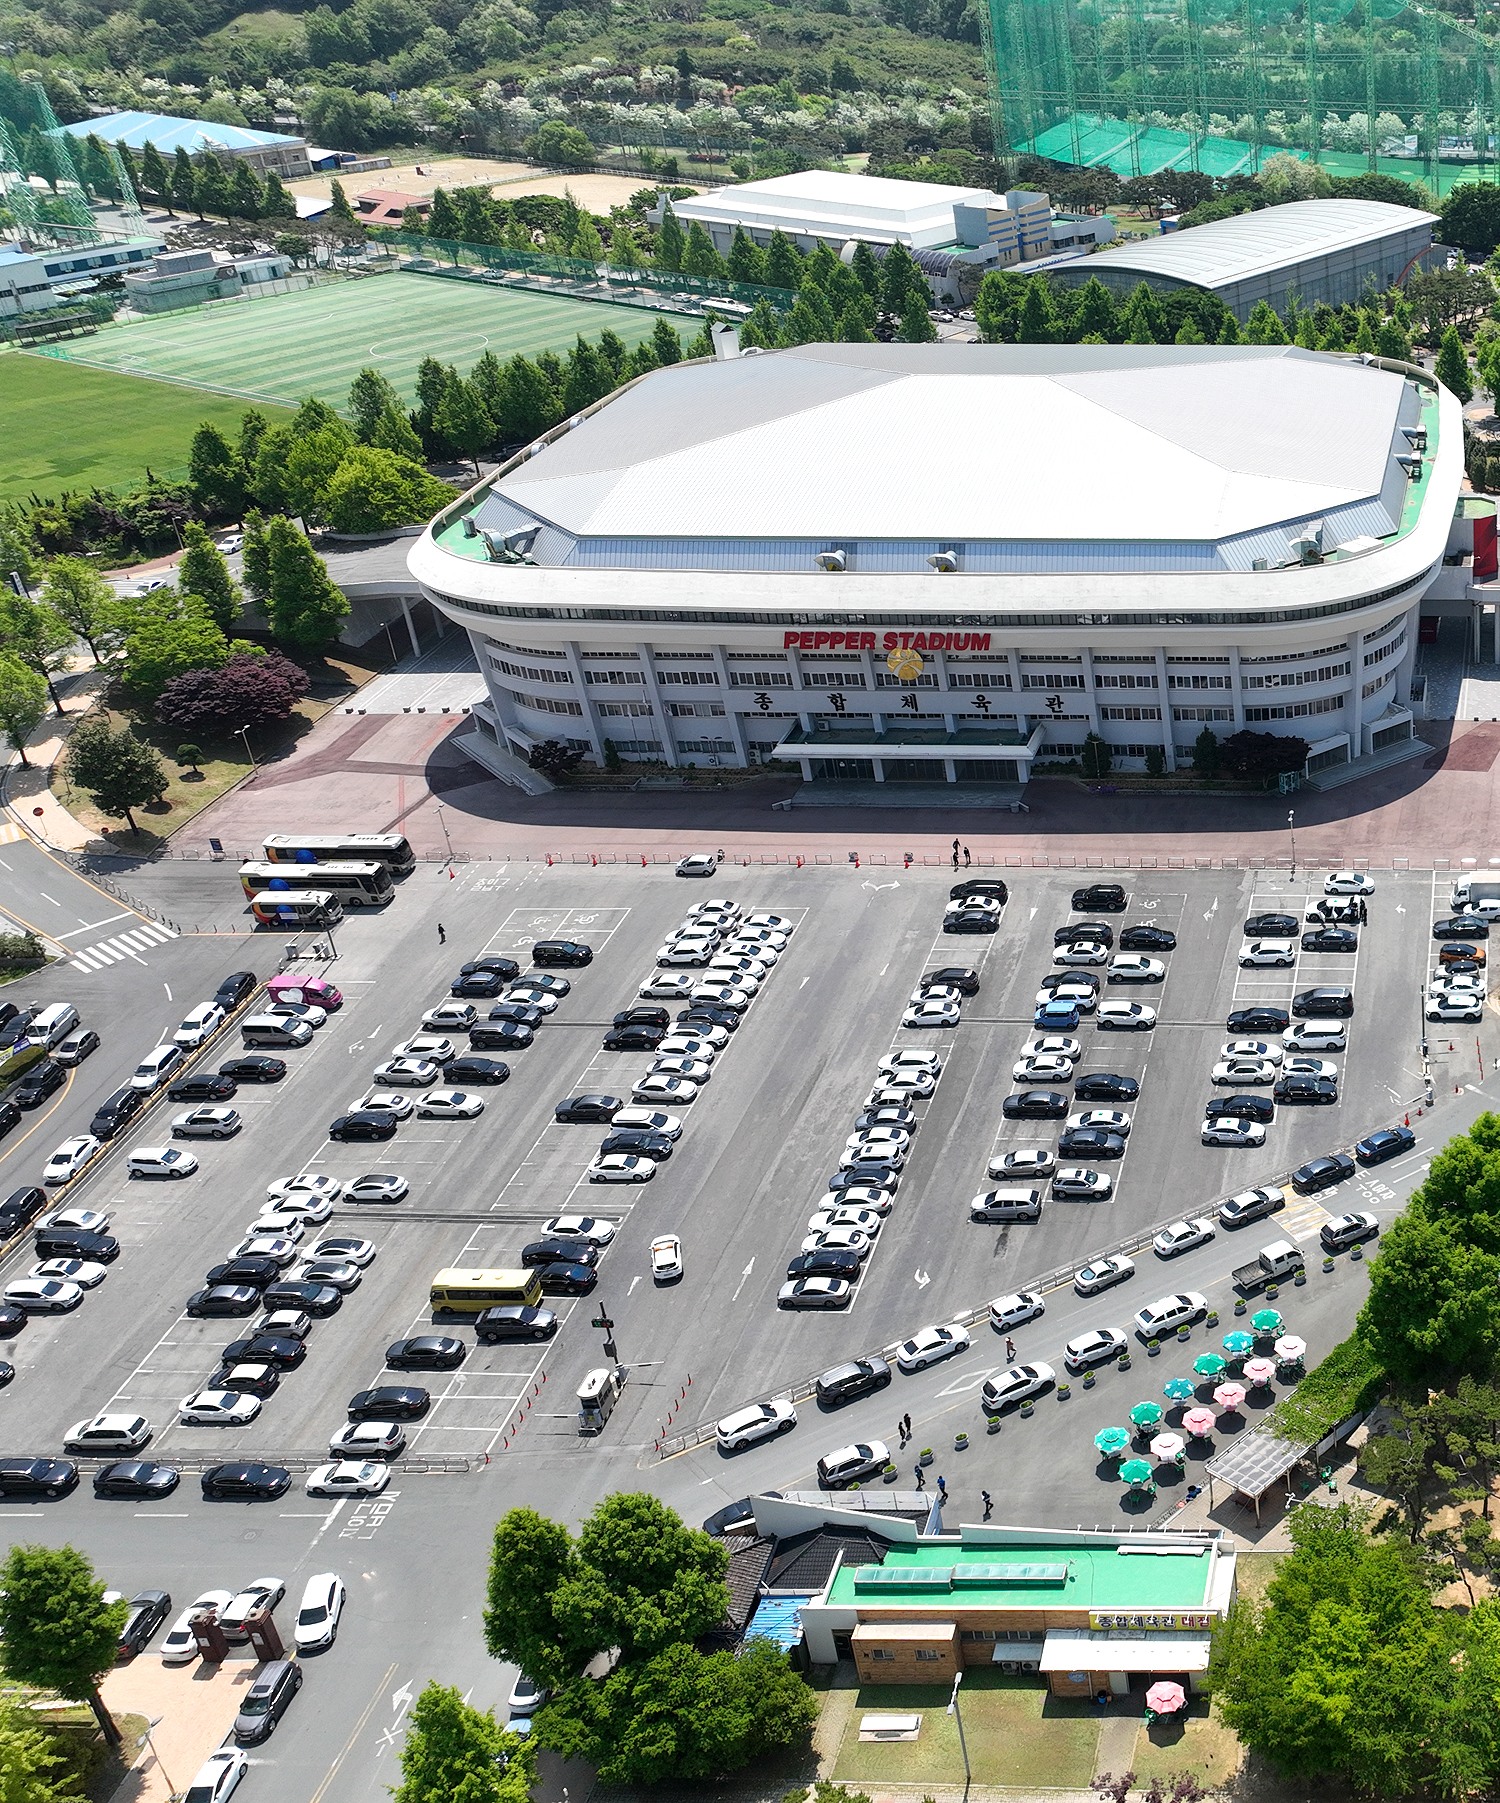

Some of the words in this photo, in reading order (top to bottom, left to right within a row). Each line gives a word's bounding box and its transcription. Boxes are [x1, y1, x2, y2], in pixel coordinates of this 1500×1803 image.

[784, 631, 877, 650] PEPPER
[883, 632, 991, 651] STADIUM
[754, 692, 1064, 714] 종합체육관
[470, 878, 511, 891] 출입구
[1356, 1180, 1397, 1205] 수영장
[1099, 1615, 1177, 1629] 종합체육관
[1181, 1615, 1211, 1628] 매점
